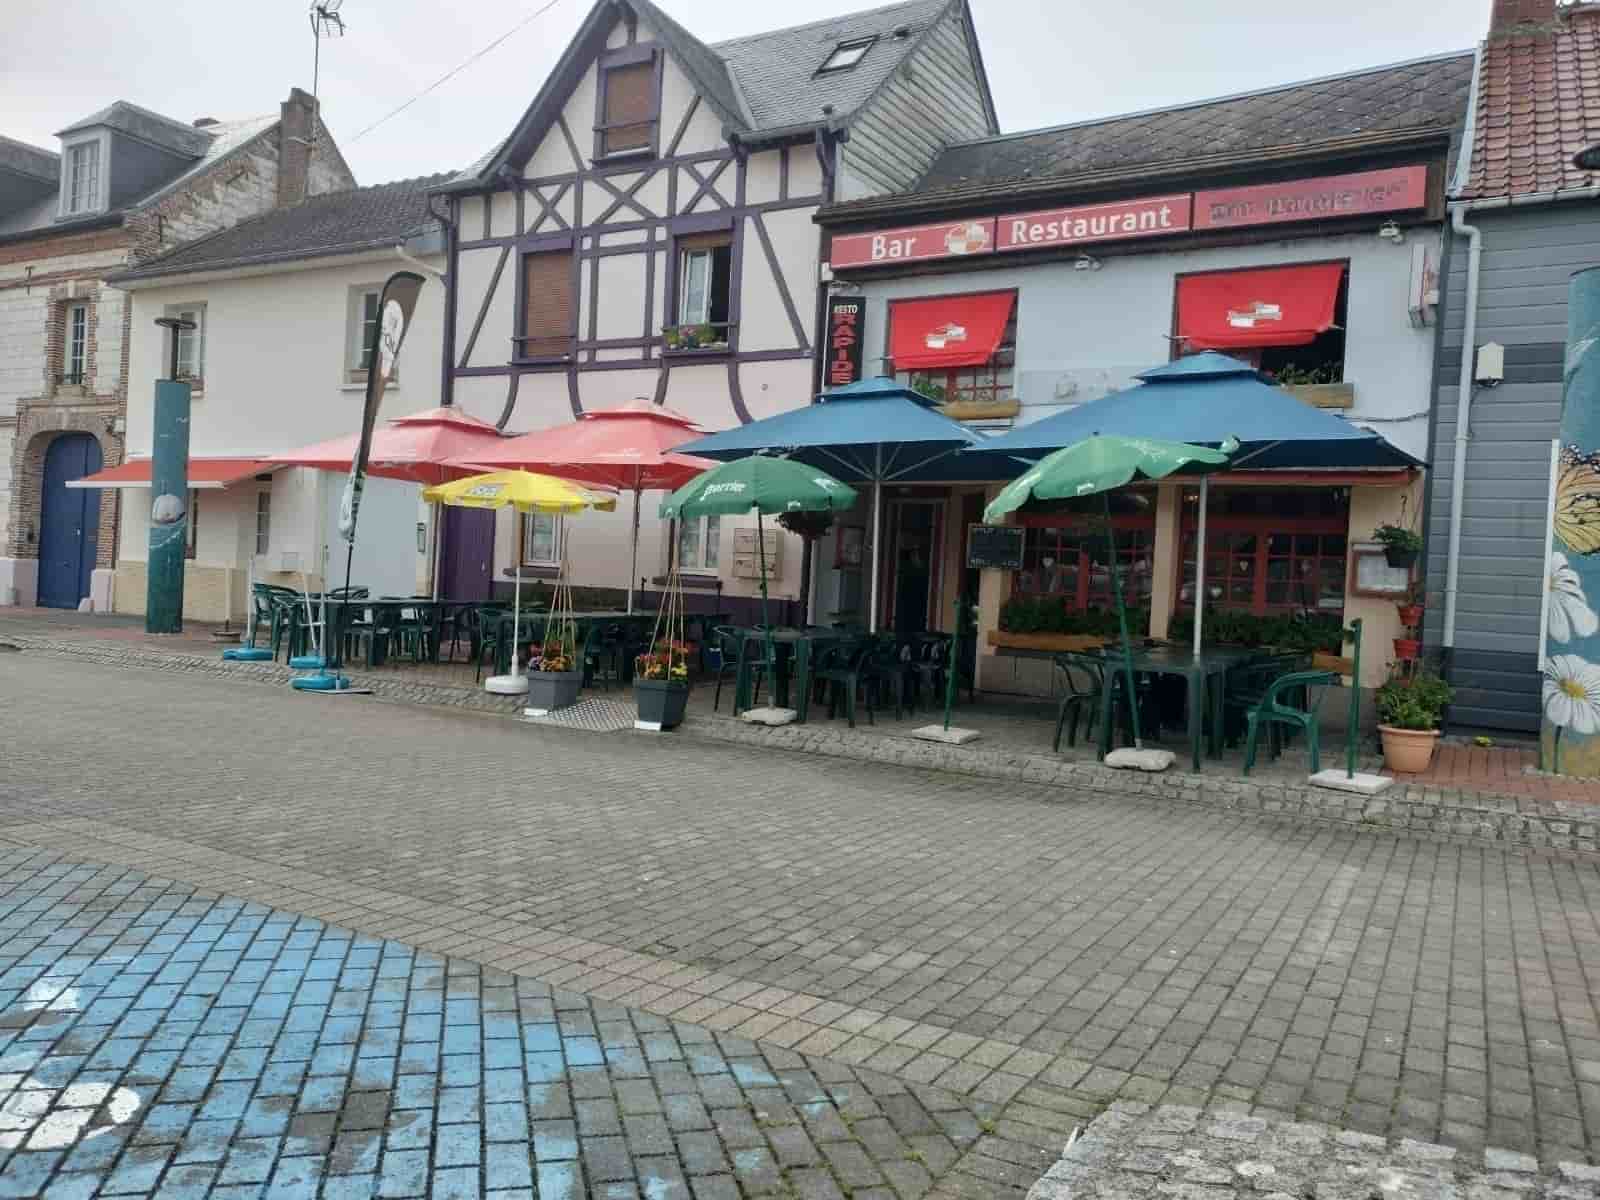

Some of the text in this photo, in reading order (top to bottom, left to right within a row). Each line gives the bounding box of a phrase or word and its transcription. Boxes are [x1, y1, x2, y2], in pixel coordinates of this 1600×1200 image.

[1011, 206, 1172, 245] Restaurant
[871, 235, 916, 260] Bar
[833, 304, 858, 314] RESTO
[832, 314, 856, 384] RAPIDE
